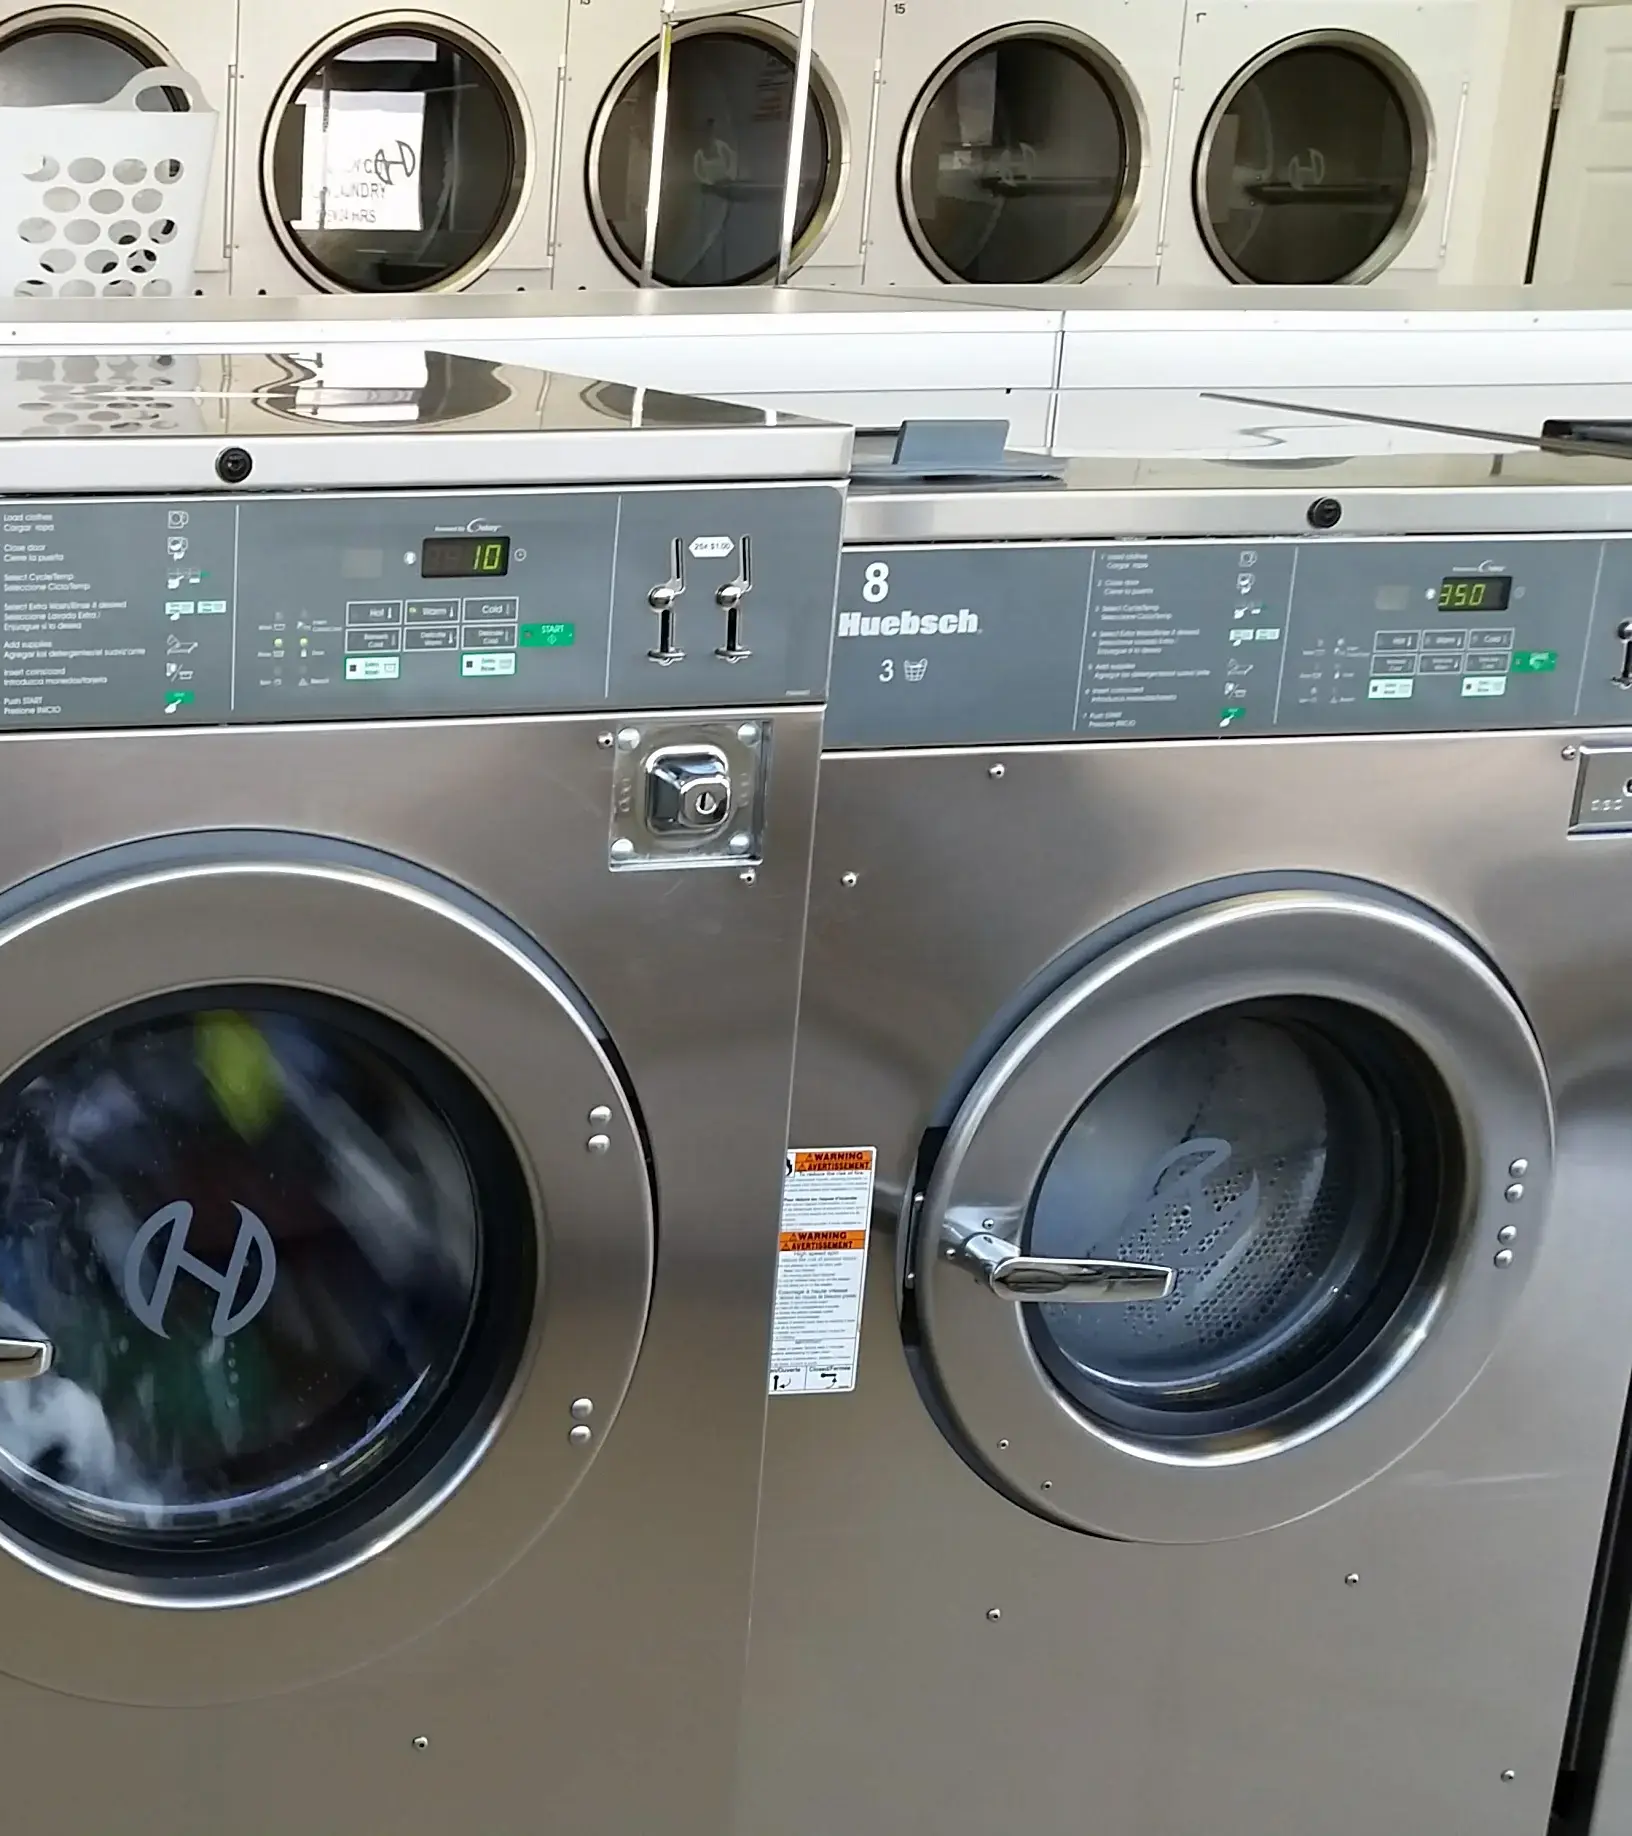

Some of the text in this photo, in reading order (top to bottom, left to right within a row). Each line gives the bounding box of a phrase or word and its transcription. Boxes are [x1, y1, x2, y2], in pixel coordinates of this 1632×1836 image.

[894, 3, 906, 15] 15
[473, 544, 502, 571] 10
[862, 562, 890, 603] 8
[1438, 583, 1486, 607] 350
[482, 604, 503, 614] Cold
[541, 624, 565, 633] START
[838, 609, 980, 638] Huebsch
[879, 659, 894, 683] 3
[814, 1152, 864, 1161] WARNING
[807, 1161, 870, 1172] AVERTISSEMENT
[798, 1231, 847, 1241] WARNING
[791, 1241, 853, 1251] AVERTISSEMENT
